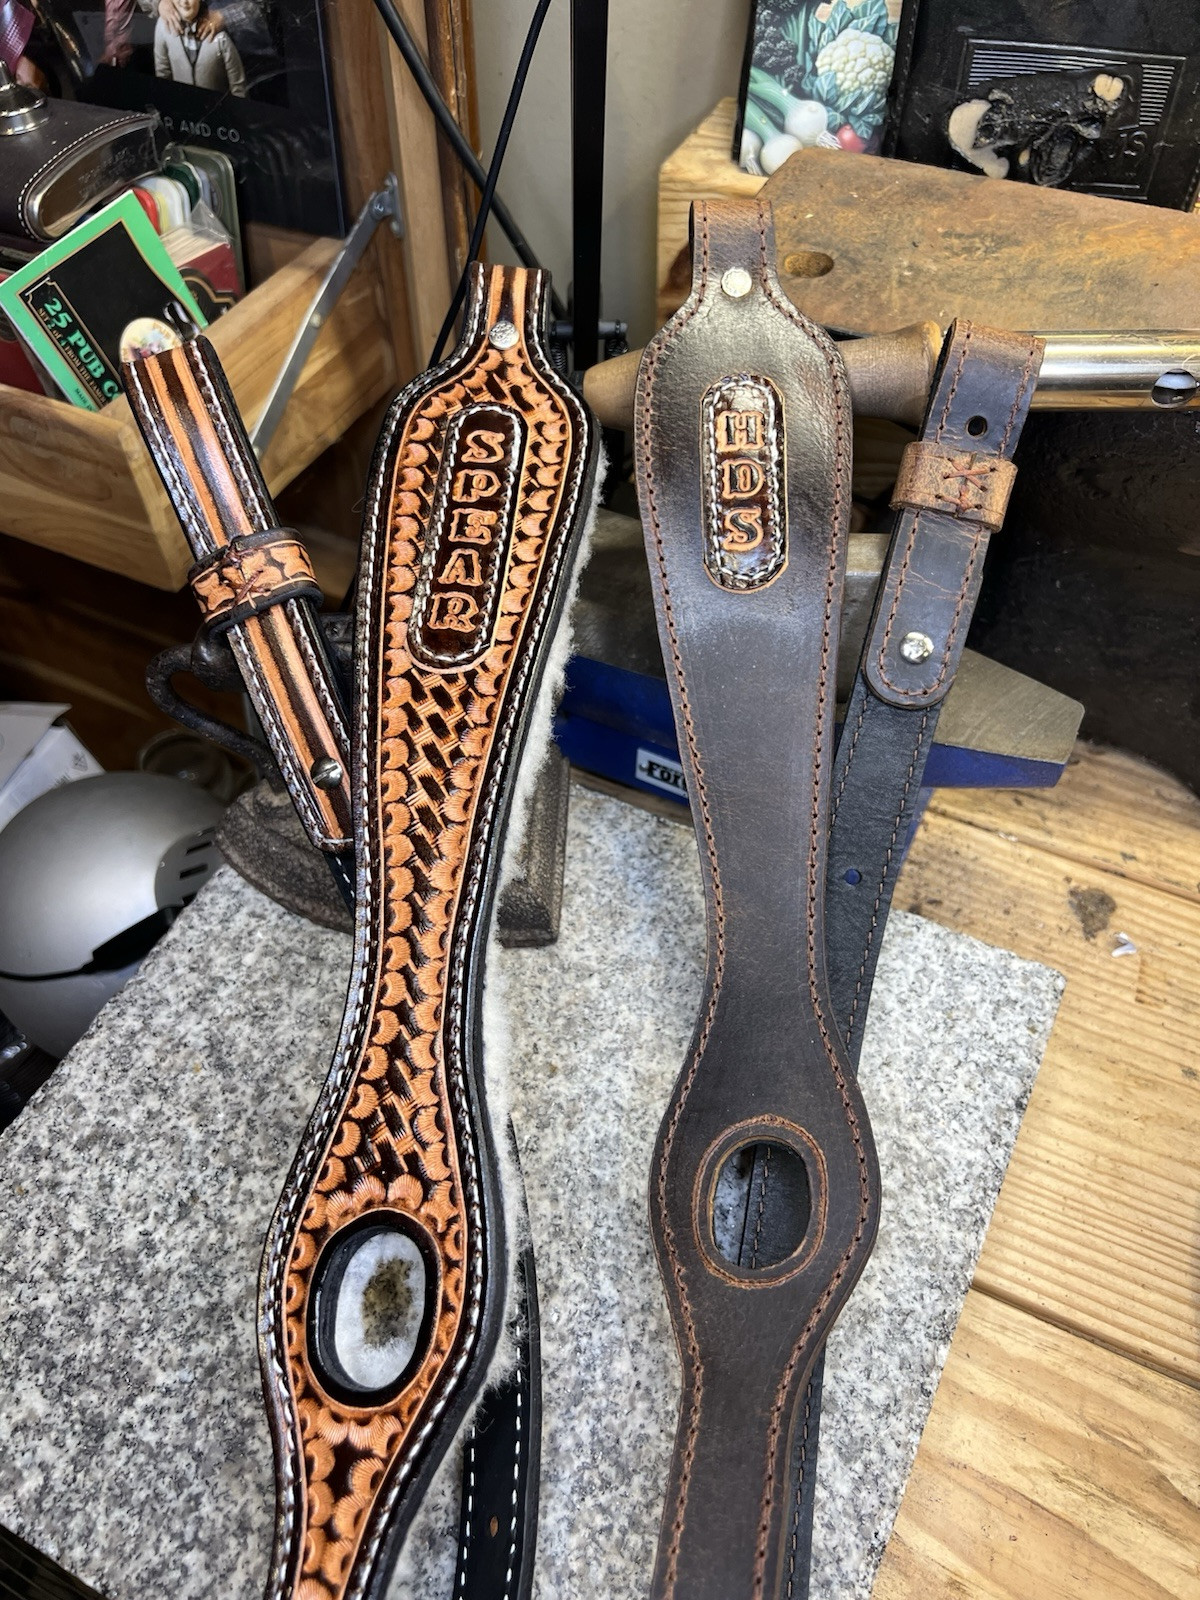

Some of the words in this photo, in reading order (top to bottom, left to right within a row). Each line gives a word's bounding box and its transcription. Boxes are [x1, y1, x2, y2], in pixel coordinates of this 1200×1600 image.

[180, 120, 212, 138] AND
[216, 126, 245, 144] CO.
[44, 297, 73, 329] 25
[66, 329, 106, 379] PUB
[427, 429, 506, 634] SPEAR
[716, 410, 765, 552] HDS
